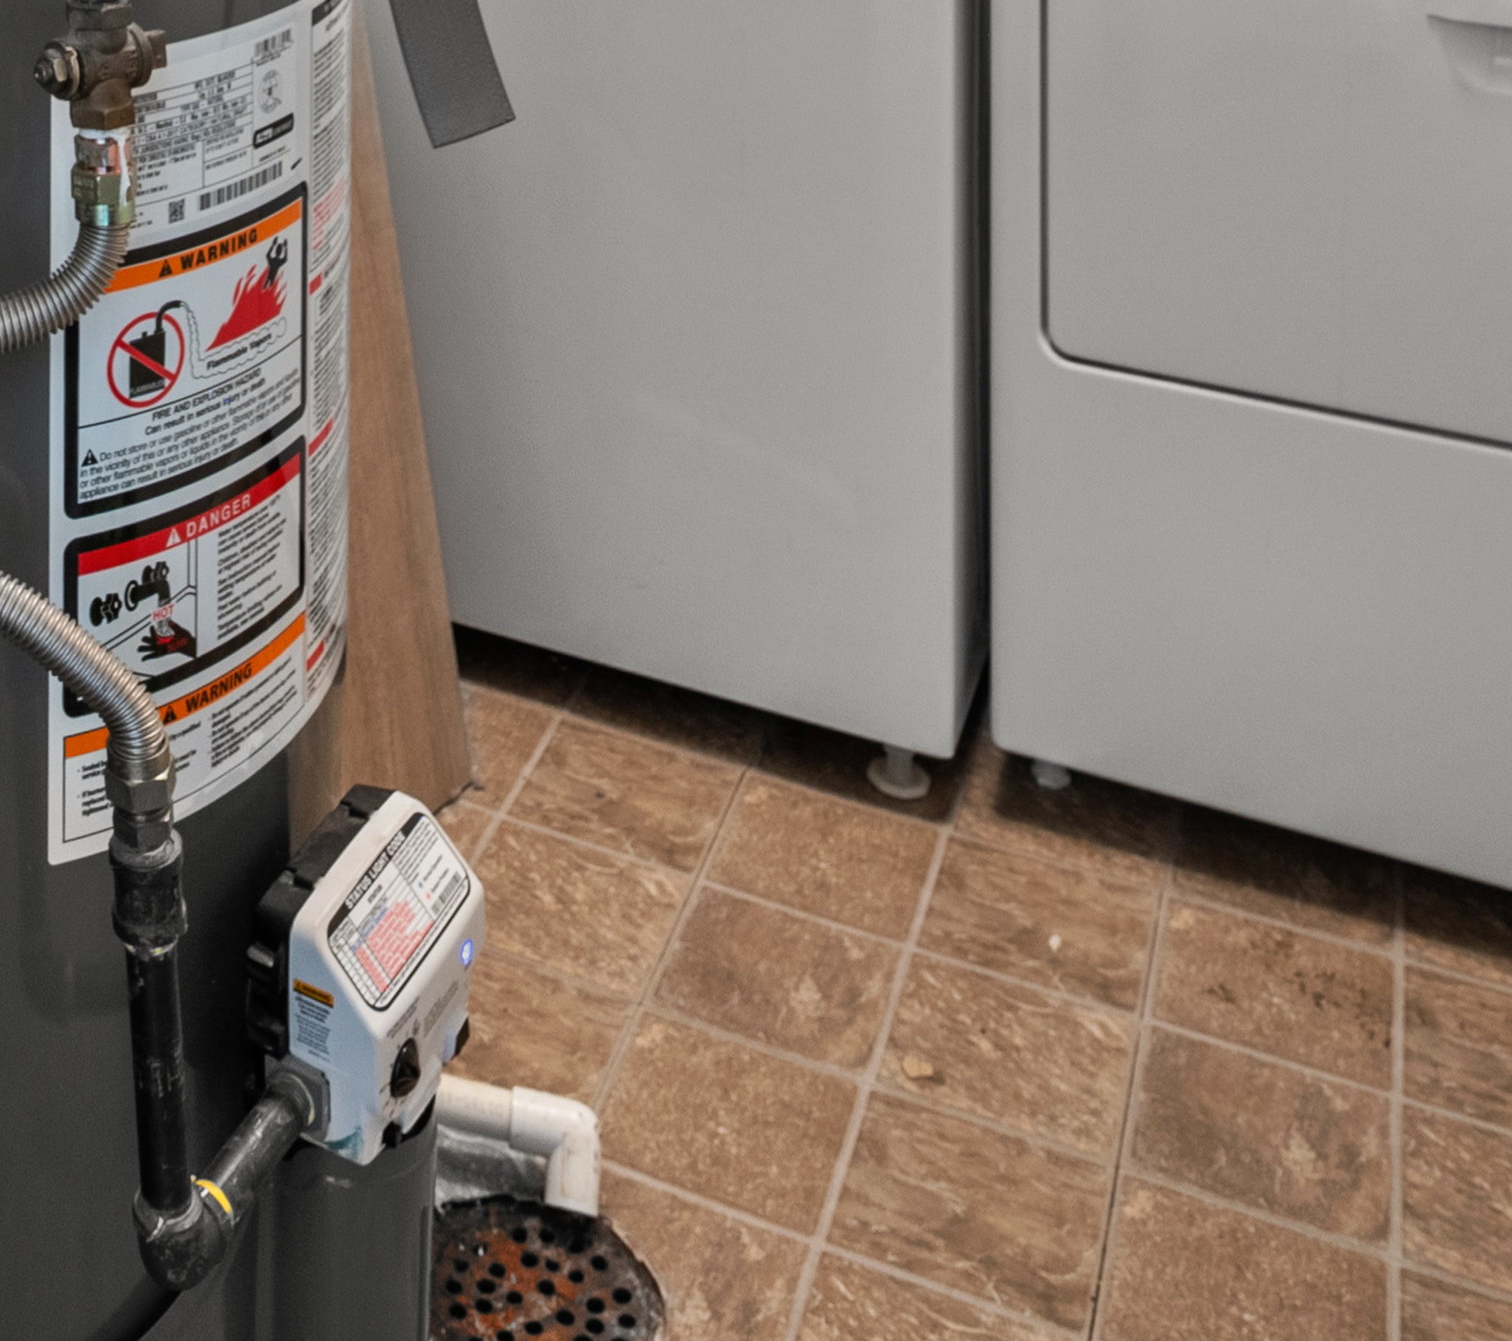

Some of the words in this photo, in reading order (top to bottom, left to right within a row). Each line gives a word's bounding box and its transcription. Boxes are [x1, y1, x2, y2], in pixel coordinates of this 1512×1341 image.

[180, 228, 258, 271] WARNING
[152, 407, 170, 421] FIRE
[173, 399, 189, 414] AND
[192, 380, 233, 407] EXPLOSION
[145, 422, 160, 436] Can
[163, 413, 184, 429] result
[99, 450, 111, 462] Do
[114, 447, 126, 458] not
[128, 441, 146, 454] store
[186, 493, 251, 538] DANGER
[152, 604, 174, 621] HOT
[185, 662, 252, 713] WARNING
[345, 875, 374, 909] STATUS
[371, 851, 391, 882] LIGHT
